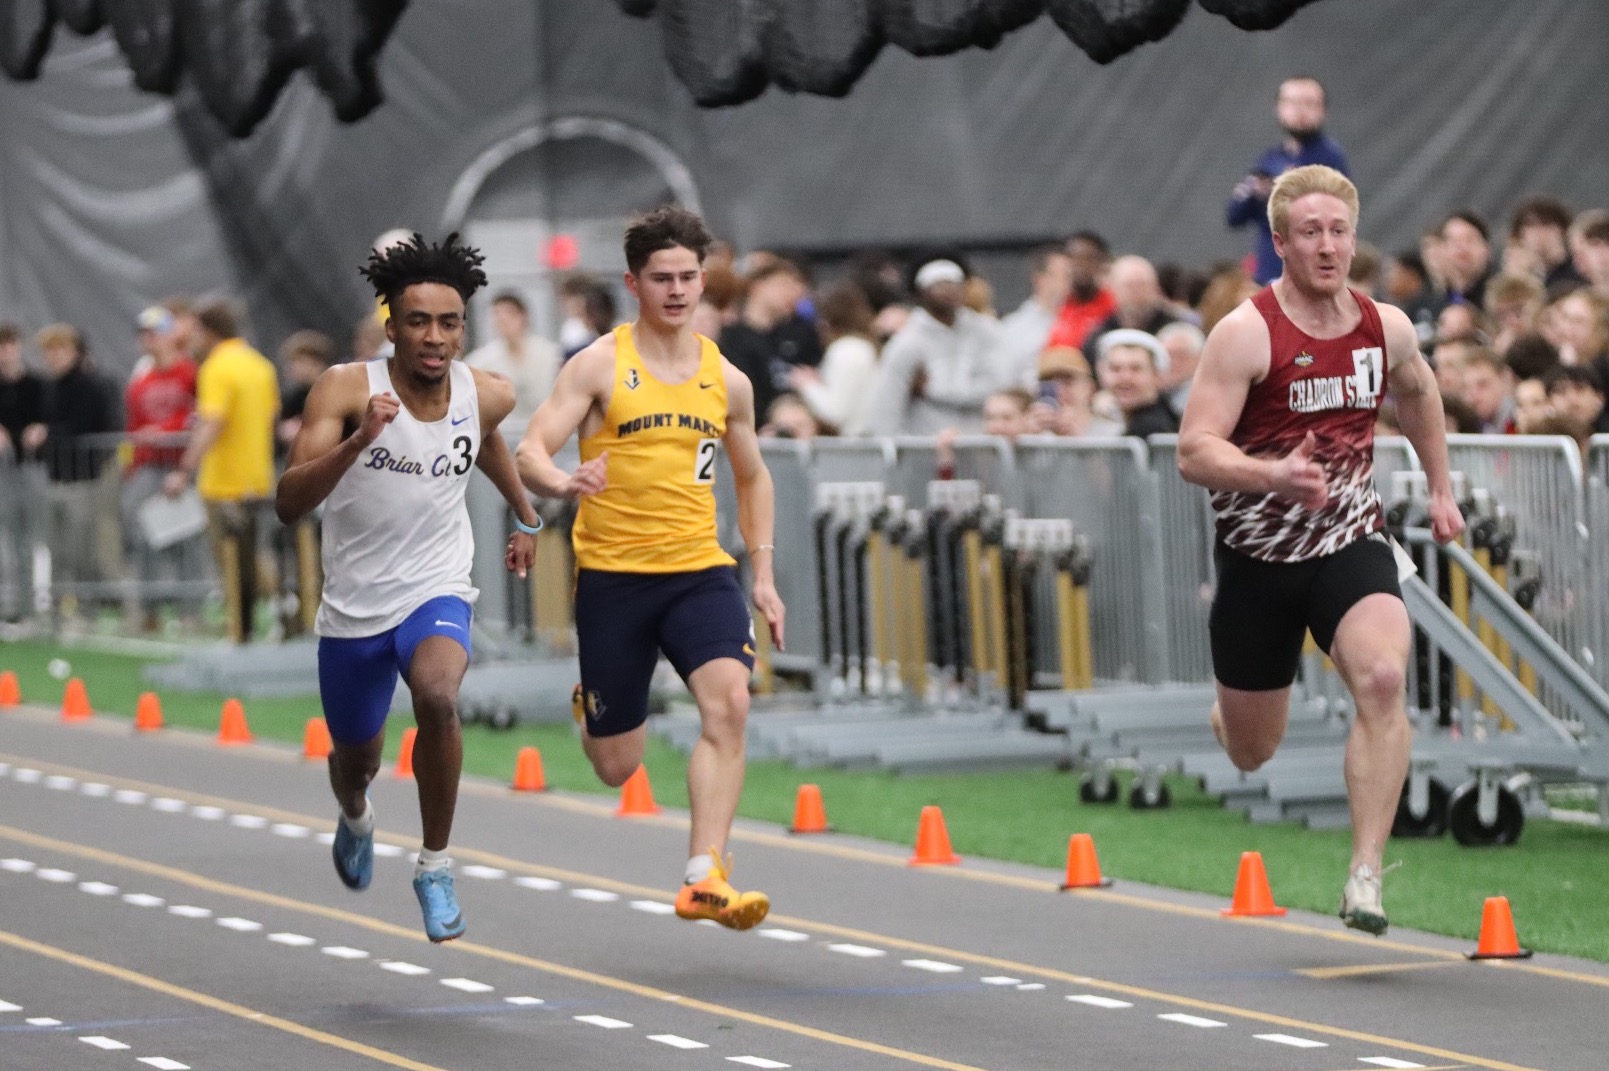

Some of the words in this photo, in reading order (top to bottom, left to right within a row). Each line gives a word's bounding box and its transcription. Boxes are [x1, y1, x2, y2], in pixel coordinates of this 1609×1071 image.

[1360, 351, 1375, 393] 1
[1288, 376, 1345, 413] CHADRON
[617, 412, 673, 438] MOUNT
[364, 446, 425, 475] Briar
[453, 435, 472, 475] 3
[698, 442, 716, 480] 2
